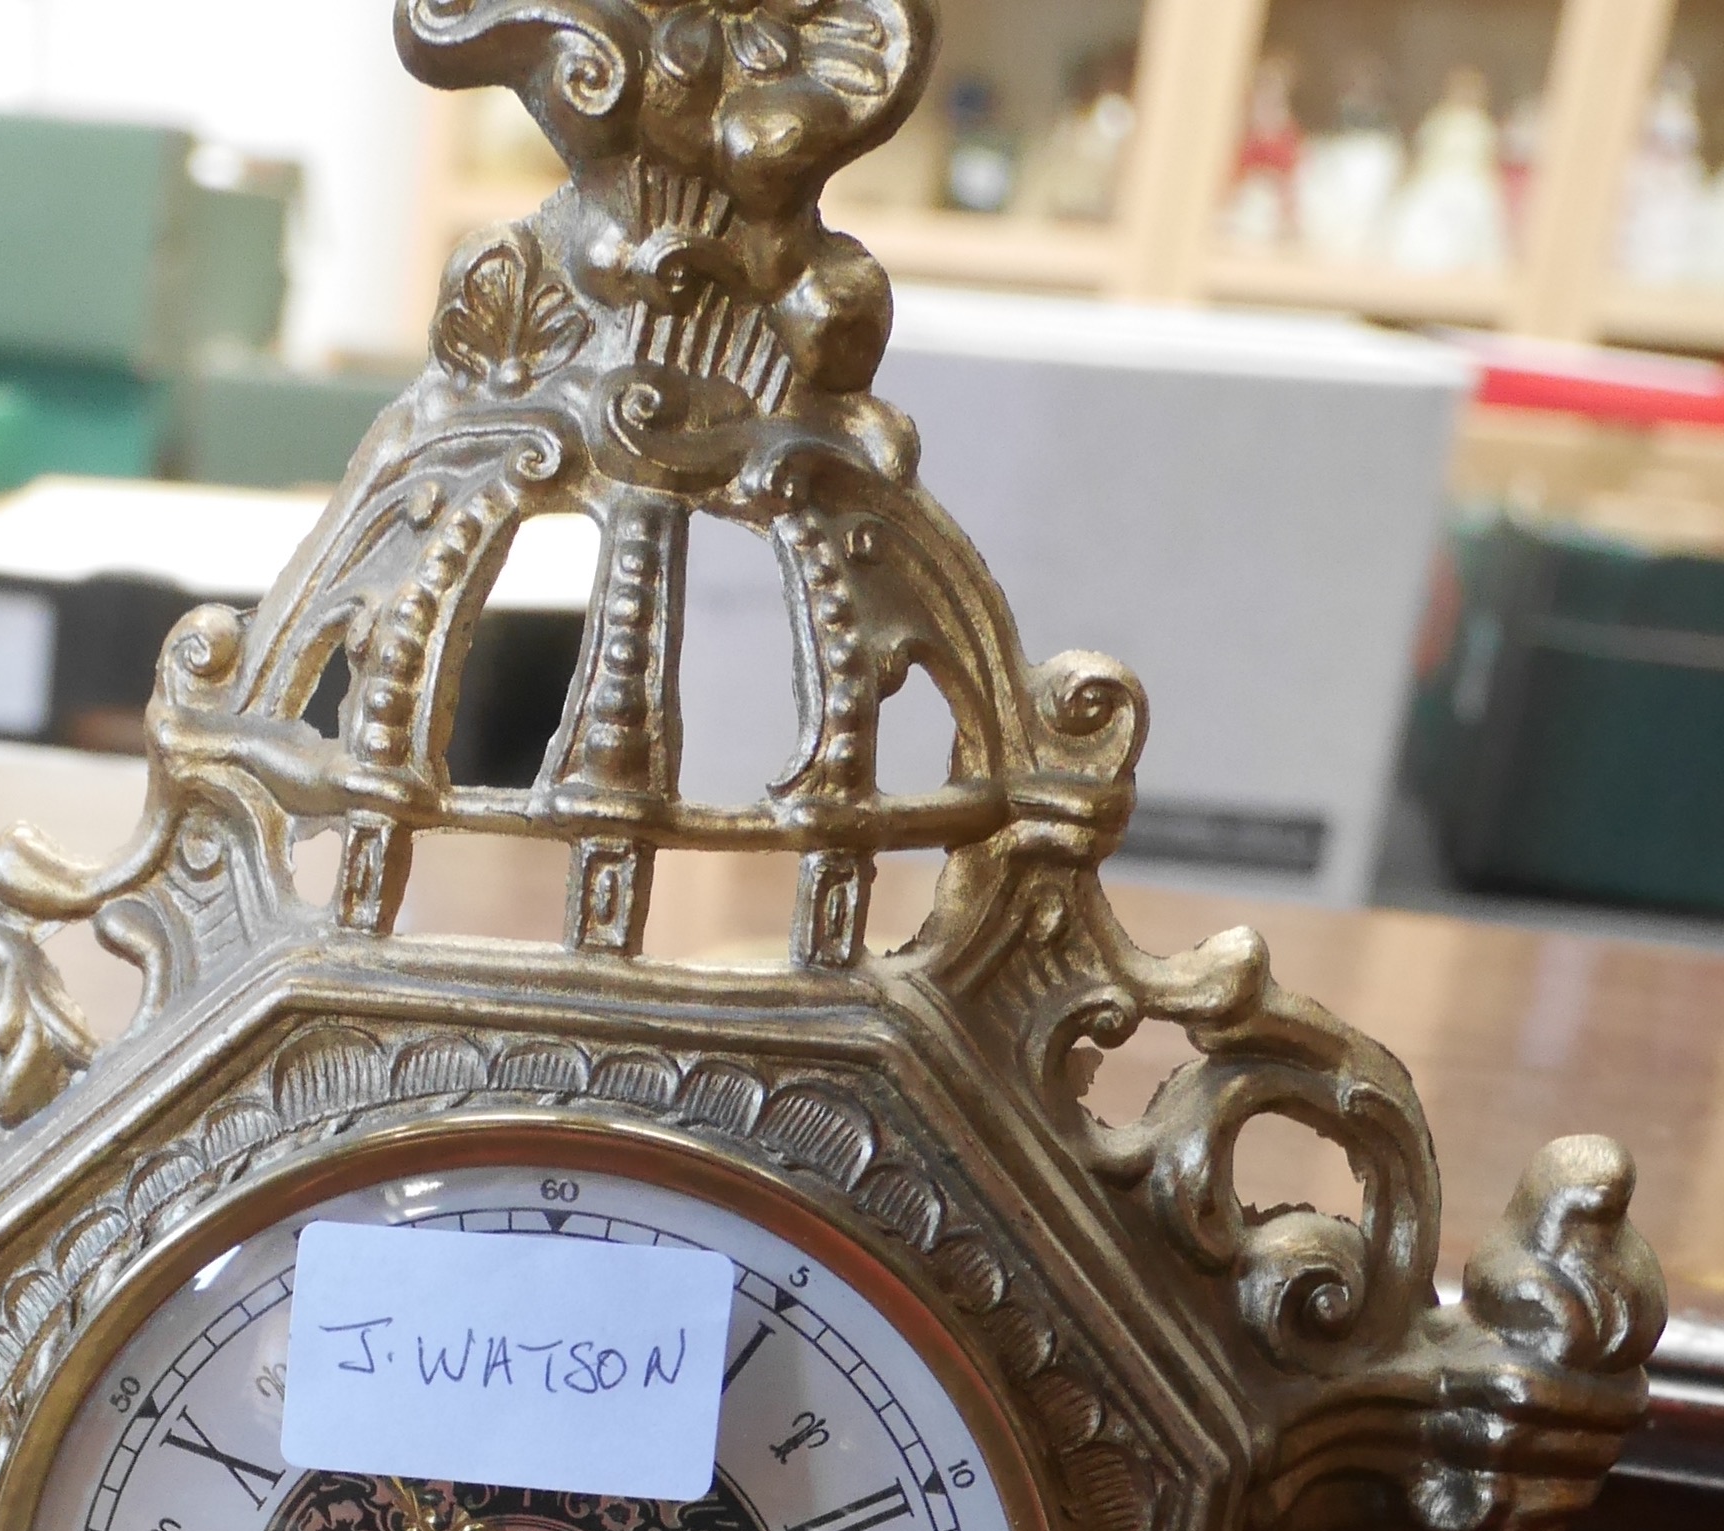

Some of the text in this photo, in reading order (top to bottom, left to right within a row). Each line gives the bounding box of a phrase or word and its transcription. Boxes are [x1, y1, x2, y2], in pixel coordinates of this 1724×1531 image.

[541, 1178, 579, 1202] 60
[789, 1266, 811, 1289] 5
[110, 1375, 142, 1415] 50
[160, 1404, 286, 1512] X
[947, 1459, 976, 1490] 10
